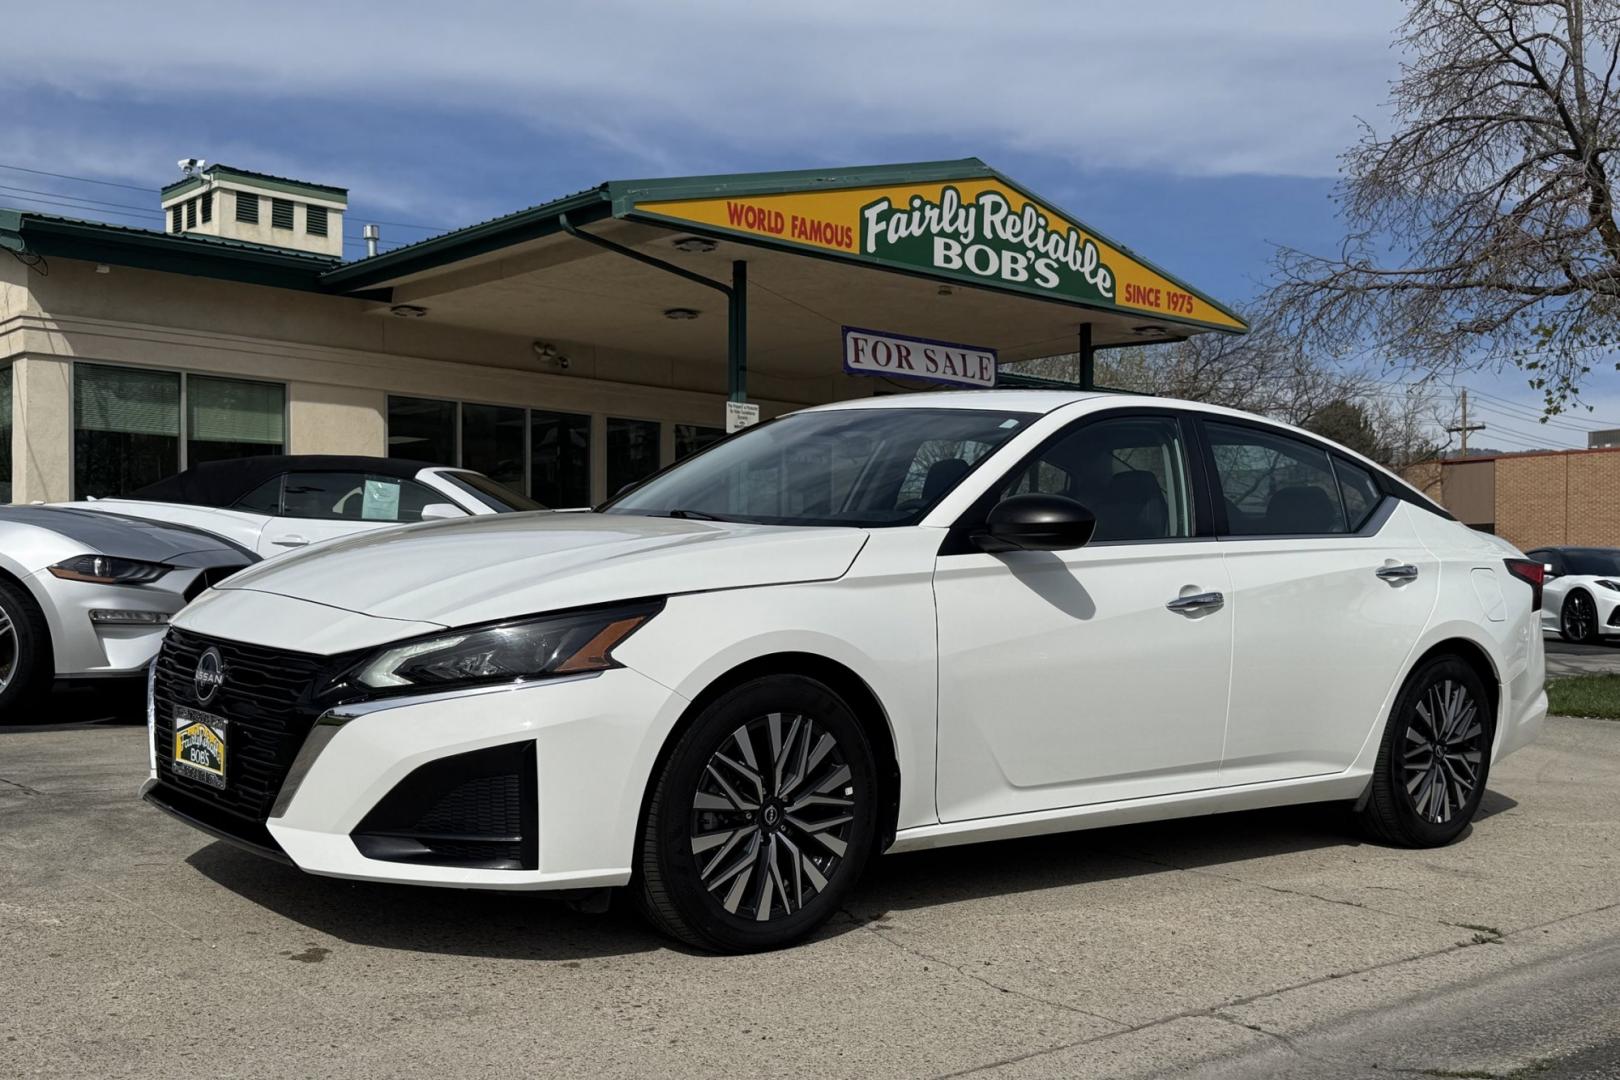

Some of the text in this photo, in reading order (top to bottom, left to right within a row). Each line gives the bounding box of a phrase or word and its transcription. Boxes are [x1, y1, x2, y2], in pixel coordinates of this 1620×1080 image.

[727, 200, 854, 249] WORLD FAMOUS
[864, 188, 1114, 298] Fairly Reliable
[932, 235, 1061, 289] BOB'S
[1124, 282, 1195, 314] SINCE 1975
[850, 336, 992, 383] FOR SALE
[195, 670, 223, 685] ISSAN
[190, 747, 210, 767] BOB'S
